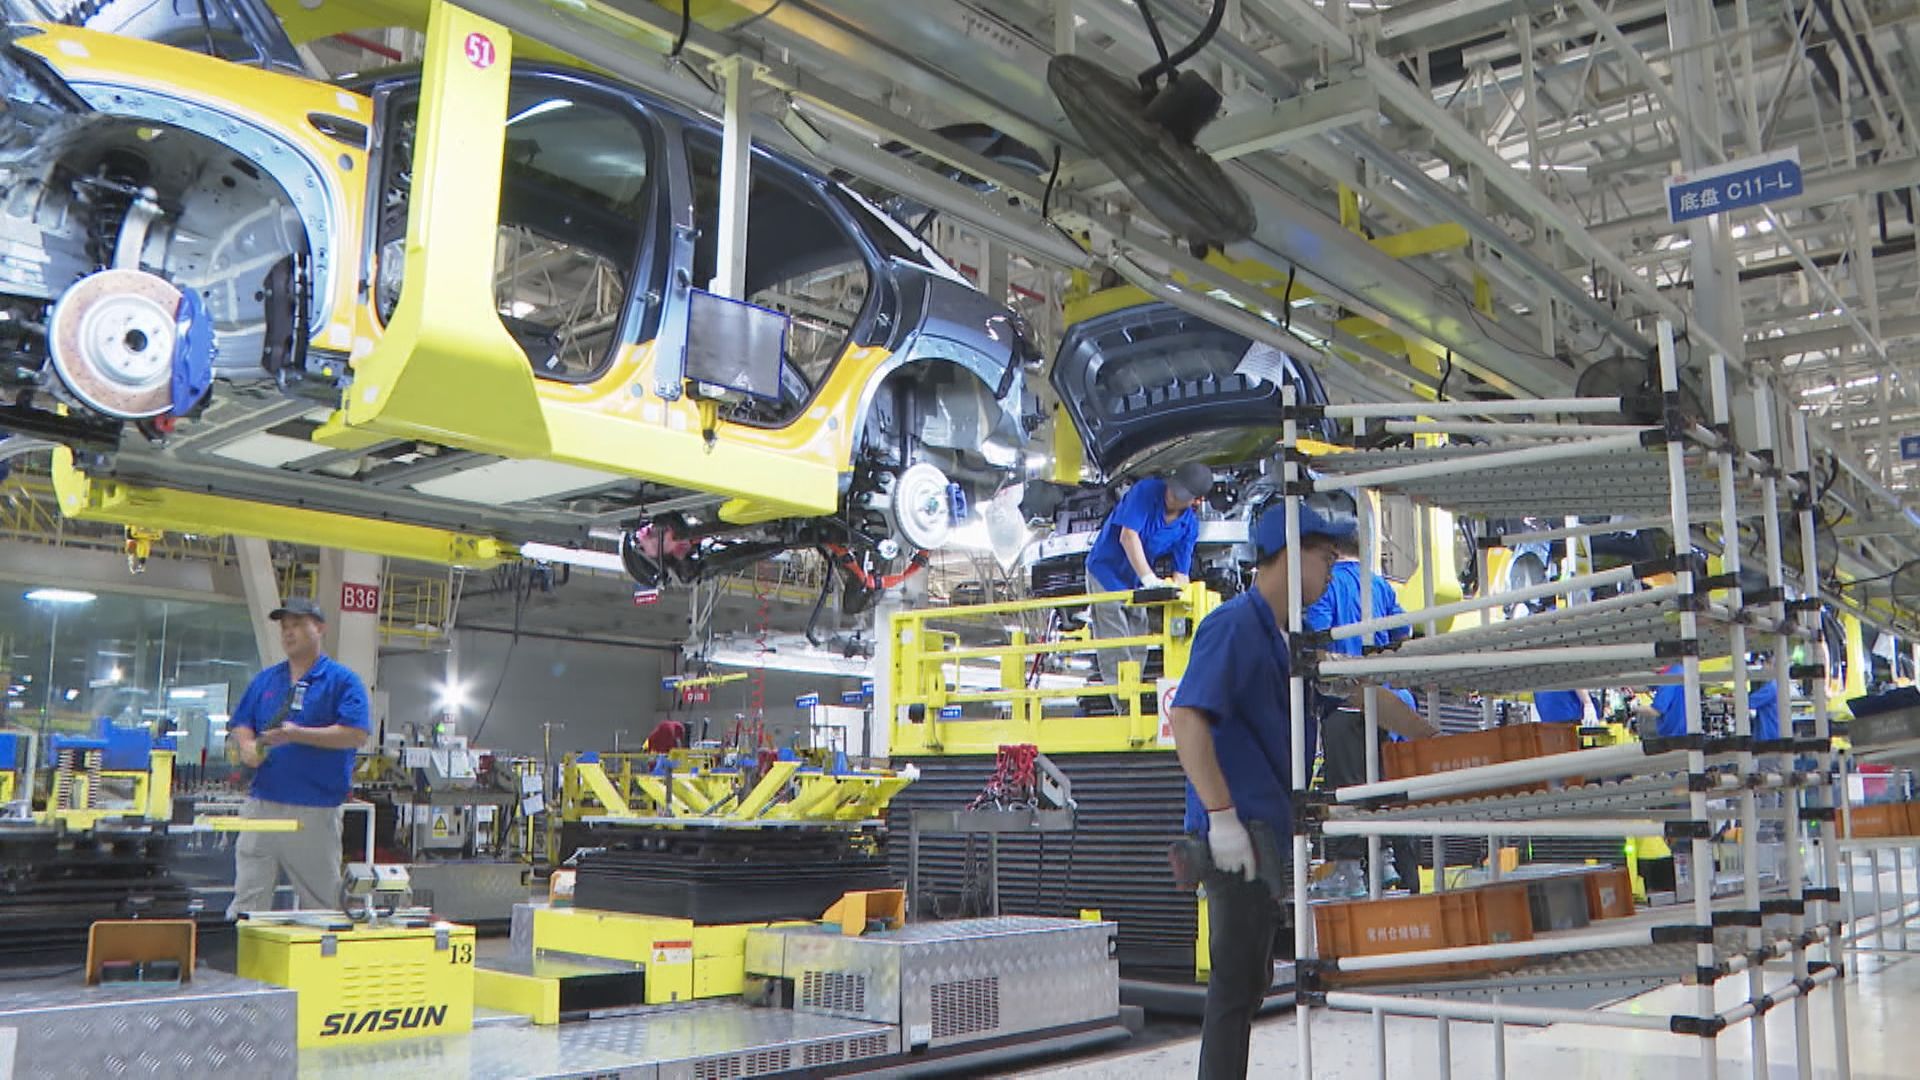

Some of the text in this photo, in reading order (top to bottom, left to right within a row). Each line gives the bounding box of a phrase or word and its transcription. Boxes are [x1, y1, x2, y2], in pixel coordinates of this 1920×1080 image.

[469, 35, 490, 66] 51
[1680, 188, 1720, 212] 底盘
[344, 587, 376, 608] B36
[449, 943, 472, 964] 13
[320, 1005, 448, 1036] SIASUN
